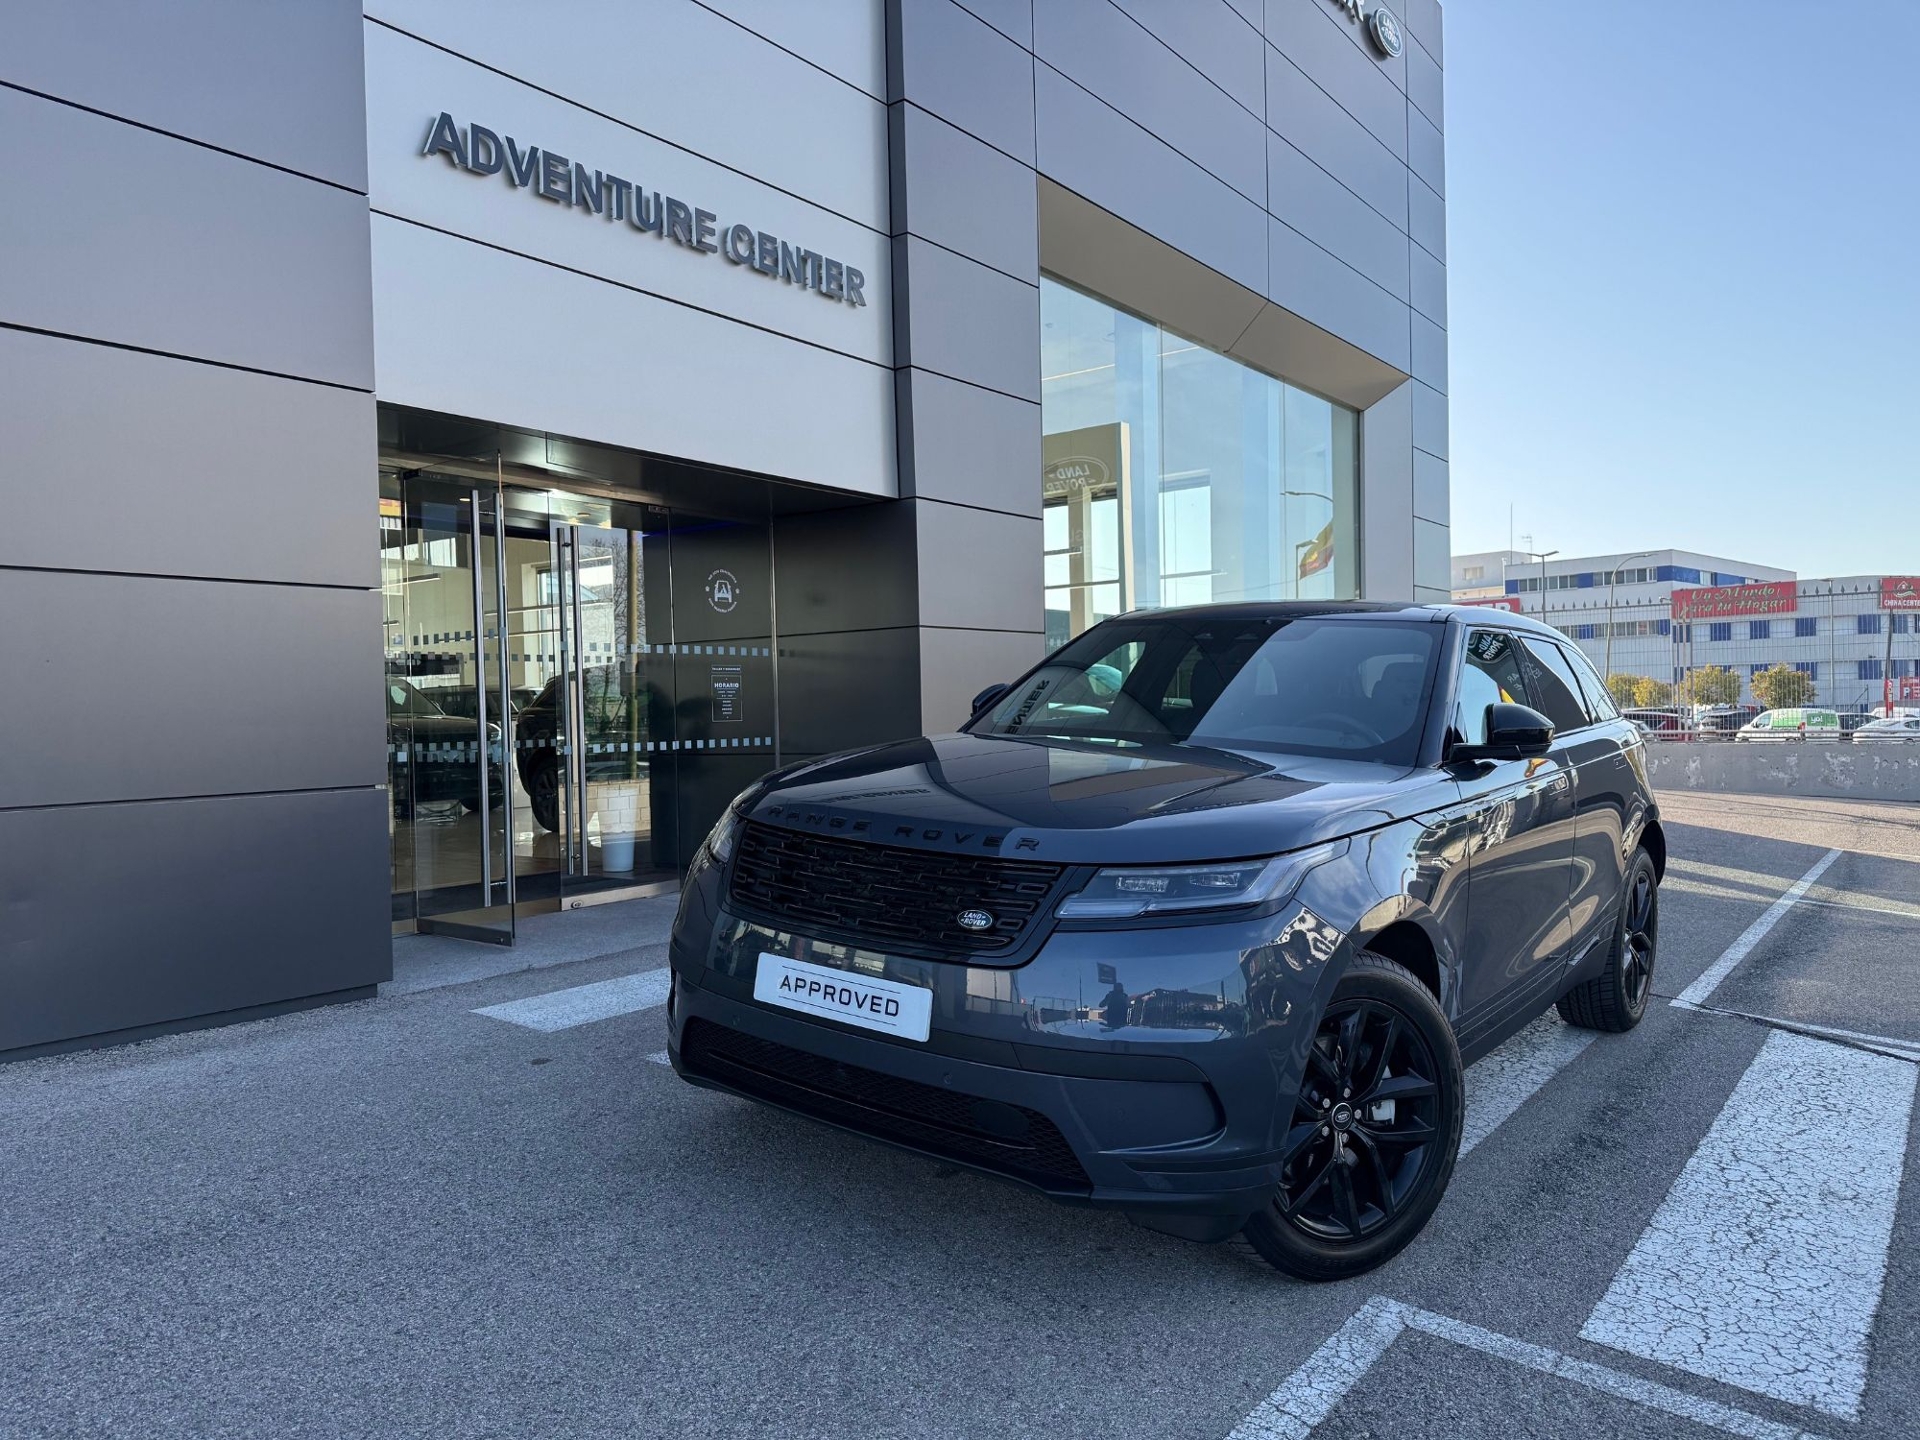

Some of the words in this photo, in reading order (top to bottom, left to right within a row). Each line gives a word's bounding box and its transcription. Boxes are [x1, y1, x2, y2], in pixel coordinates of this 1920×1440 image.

[423, 111, 718, 254] ADVENTURE
[726, 223, 867, 307] CENTER
[768, 805, 873, 831] RANGE
[894, 825, 1040, 851] ROVER
[963, 911, 982, 919] LAND
[963, 918, 987, 926] ROVER
[779, 974, 900, 1017] APPROVED
